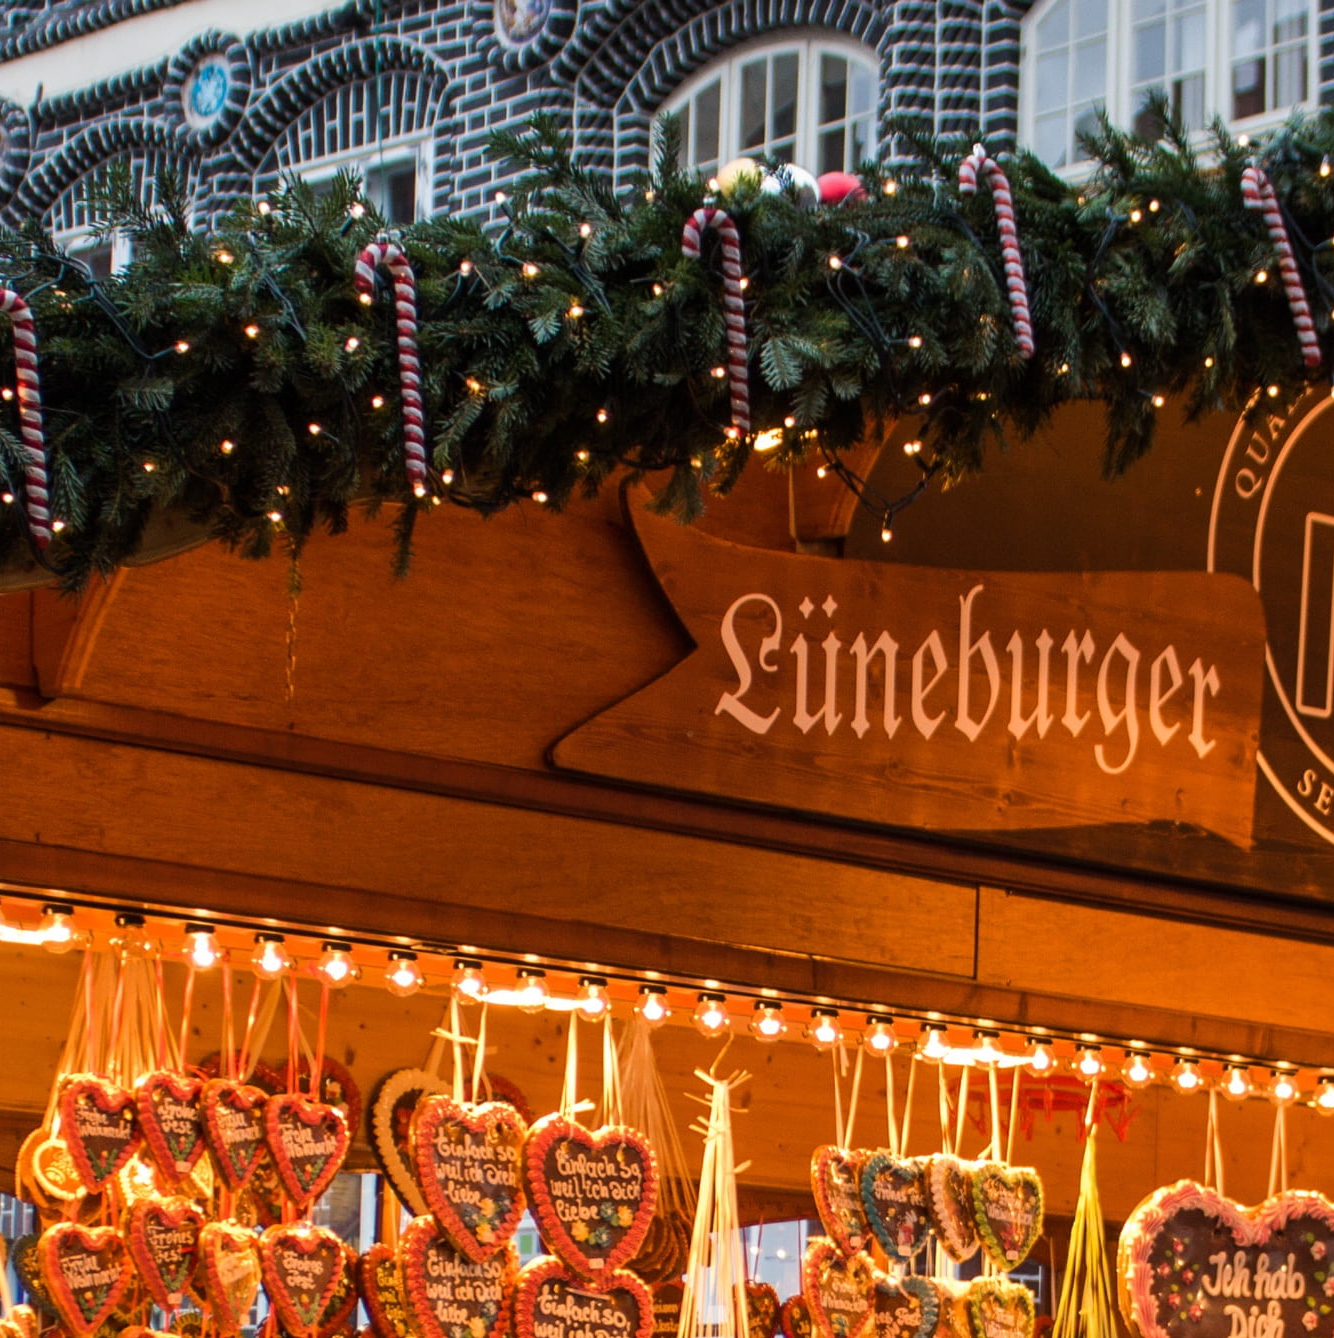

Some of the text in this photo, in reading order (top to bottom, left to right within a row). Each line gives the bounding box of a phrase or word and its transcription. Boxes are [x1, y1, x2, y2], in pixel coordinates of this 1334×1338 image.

[1235, 408, 1289, 499] QUA
[716, 583, 1221, 774] Lüneburger
[555, 1148, 617, 1179] Einfach
[555, 1199, 600, 1222] liebe
[427, 1249, 482, 1281] Einfach
[1202, 1251, 1305, 1299] Ich hab
[435, 1302, 469, 1327] liebe
[537, 1284, 601, 1324] Einfach
